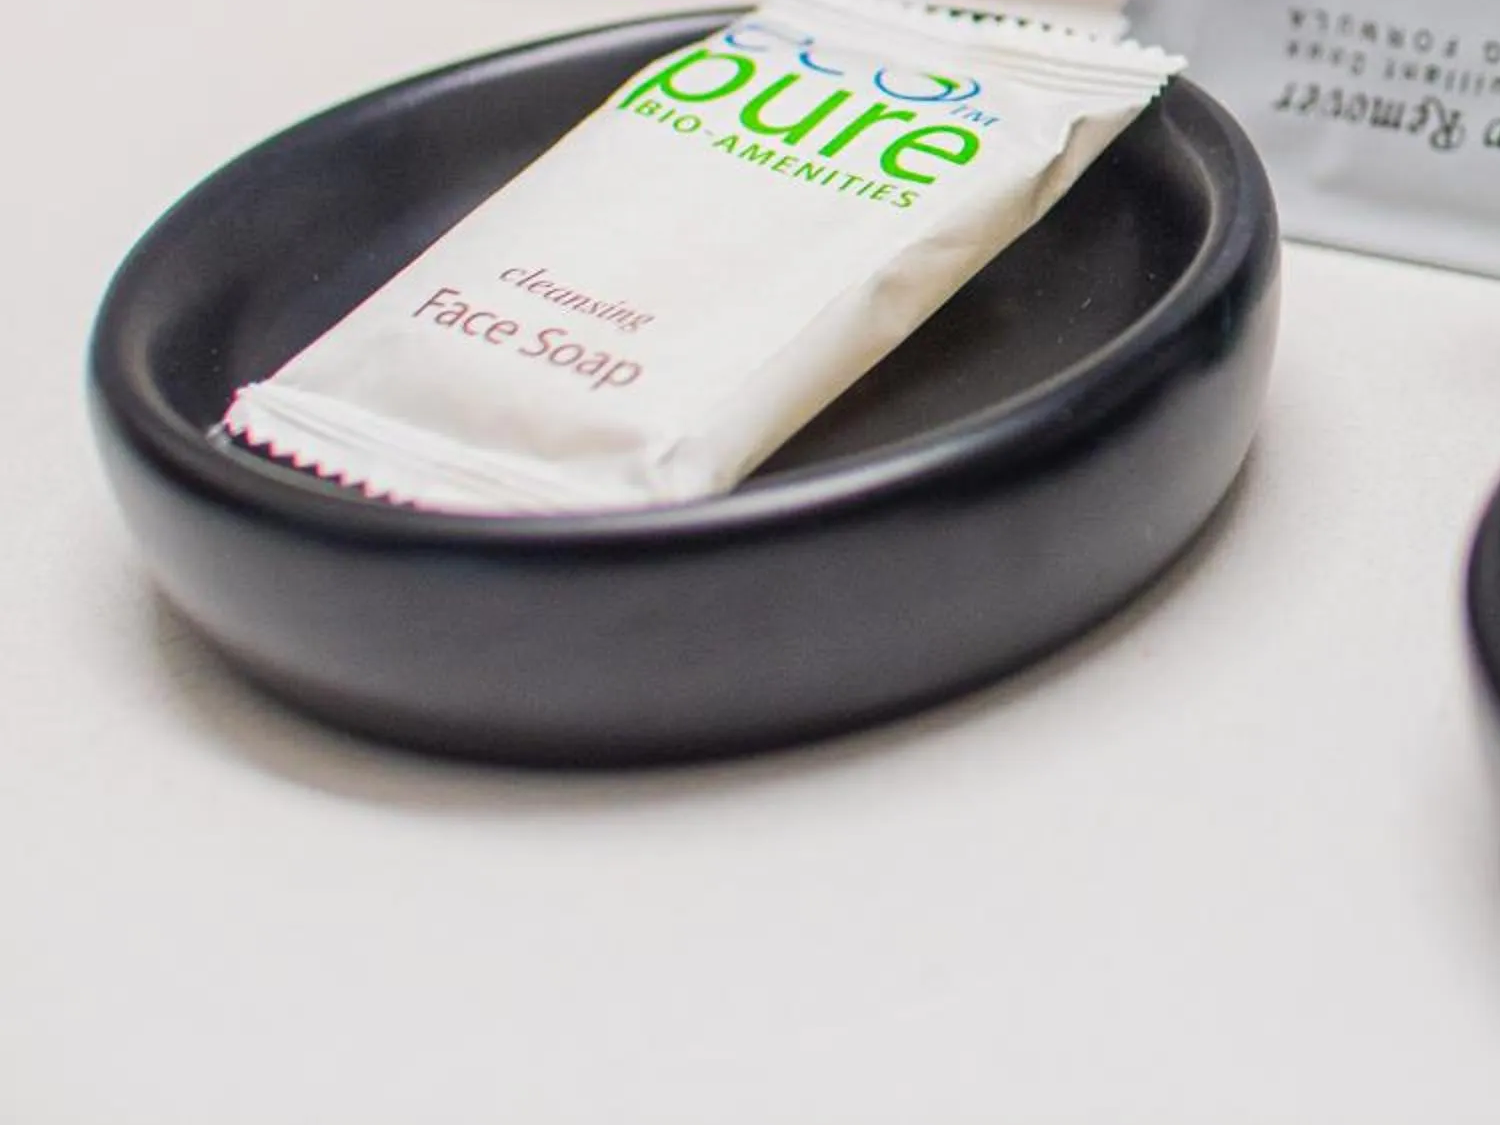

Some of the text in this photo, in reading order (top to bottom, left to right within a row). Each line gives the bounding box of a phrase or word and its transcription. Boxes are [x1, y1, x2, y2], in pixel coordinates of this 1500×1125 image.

[1288, 7, 1459, 58] FORMULA
[616, 48, 981, 186] pure
[634, 99, 924, 210] BIO-AMENITIES
[1271, 82, 1466, 152] Remover
[411, 287, 645, 391] Face Soap
[499, 267, 655, 333] cleansing
